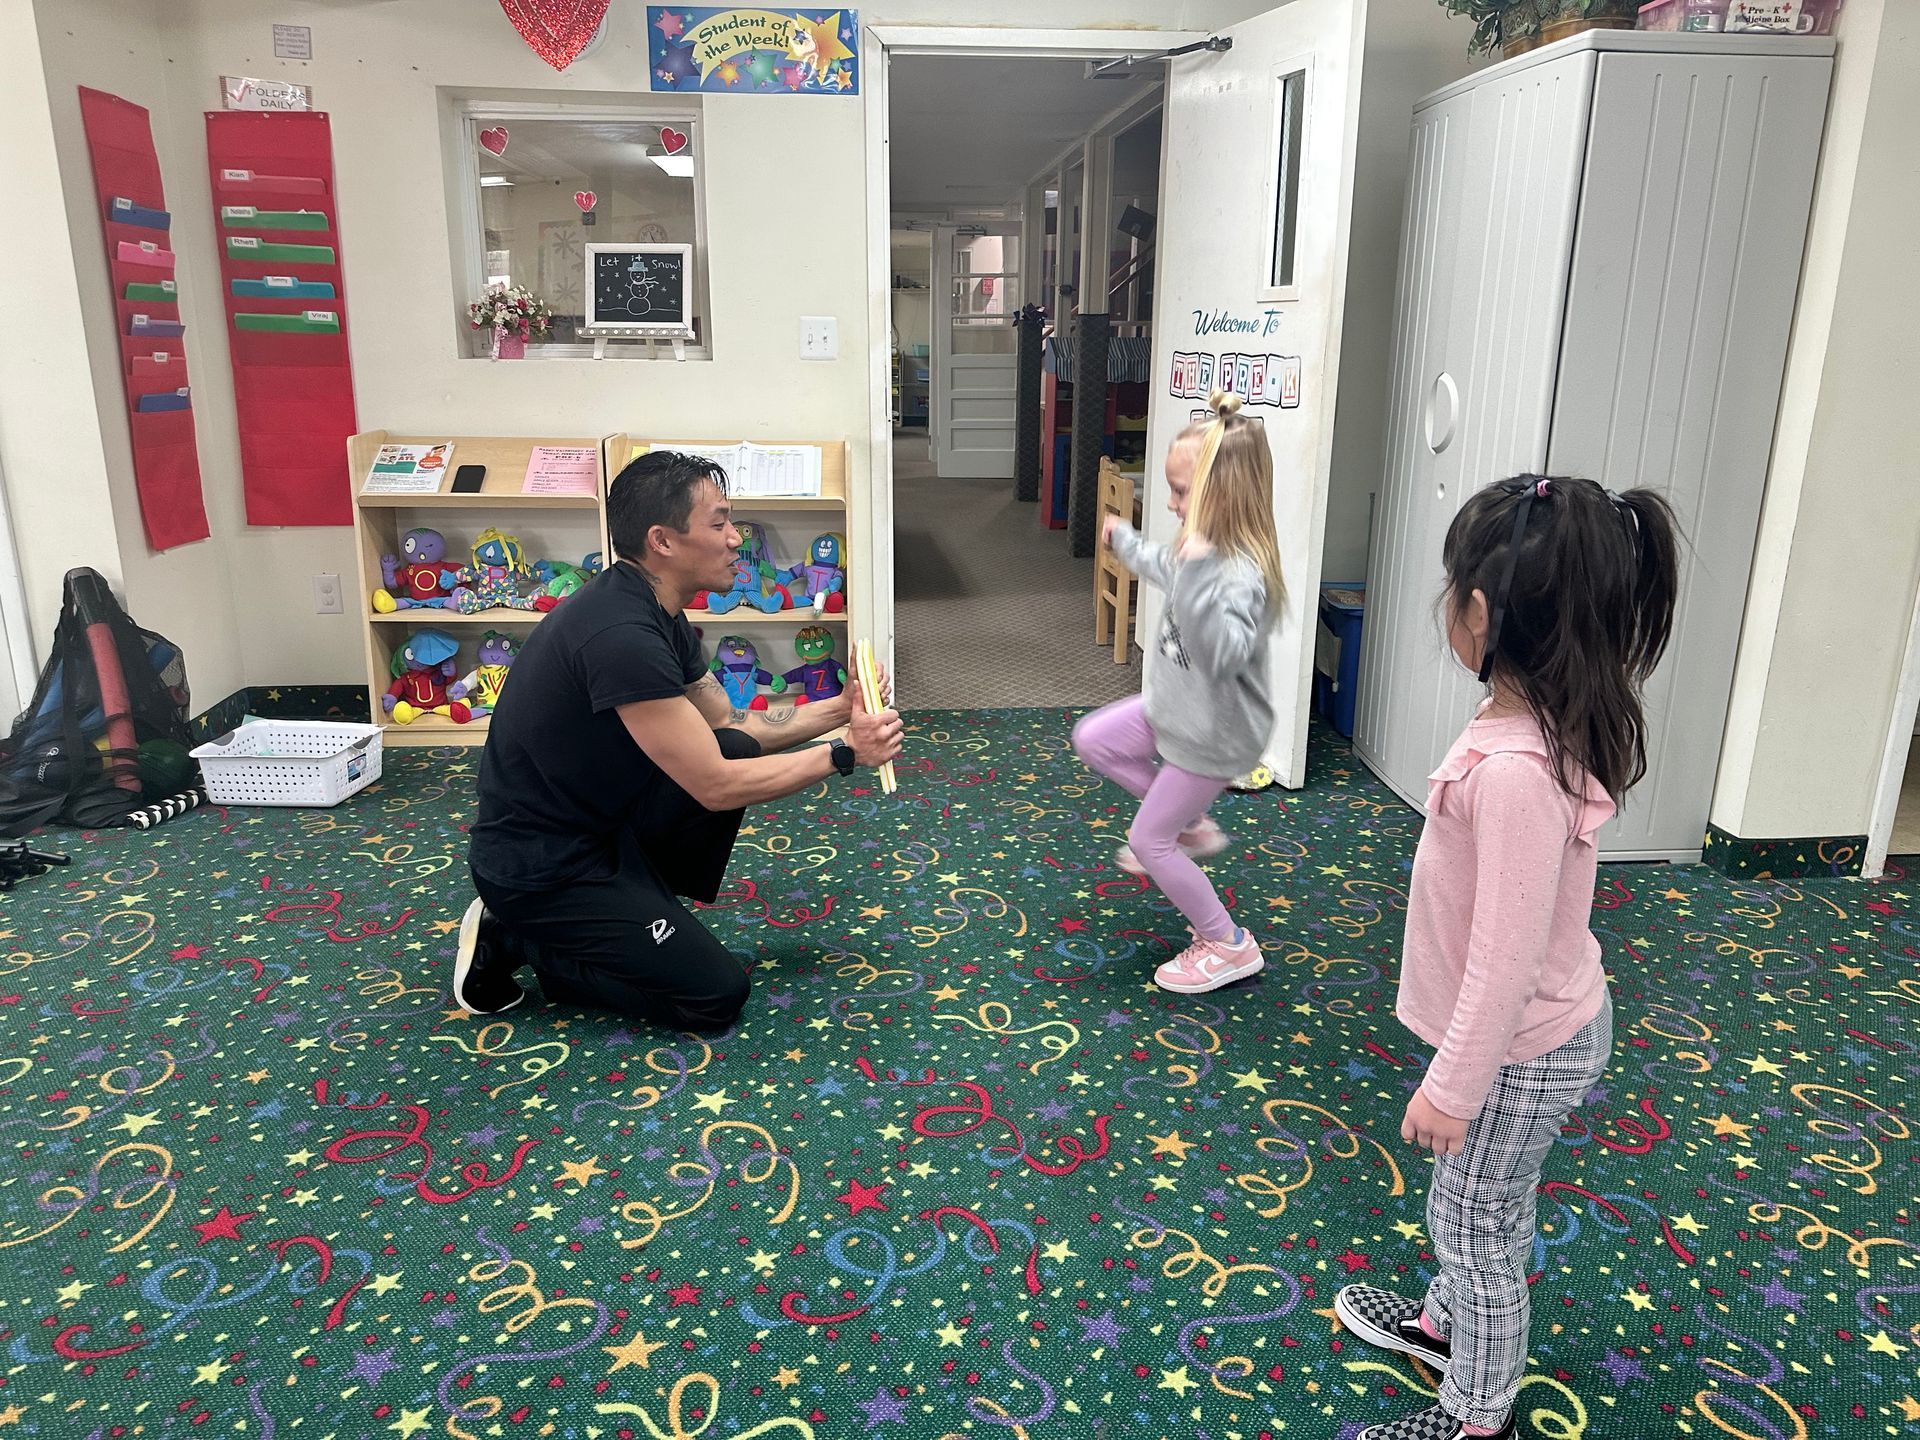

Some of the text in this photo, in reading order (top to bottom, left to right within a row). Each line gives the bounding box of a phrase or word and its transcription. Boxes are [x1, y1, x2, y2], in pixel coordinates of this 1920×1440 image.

[699, 15, 792, 44] Student of
[1774, 15, 1790, 23] Box
[704, 33, 790, 60] the Week!
[249, 87, 306, 100] FOLDERS
[260, 99, 294, 110] DAILY
[600, 254, 681, 271] Let it Snow!
[1192, 308, 1284, 338] Welcome To
[1172, 357, 1298, 401] THE PRE-K
[415, 570, 437, 591] O
[488, 566, 507, 589] P
[736, 561, 751, 583] S
[812, 570, 828, 594] T
[415, 679, 434, 703] U
[487, 672, 507, 695] V
[732, 672, 750, 695] Y
[812, 670, 830, 691] Z
